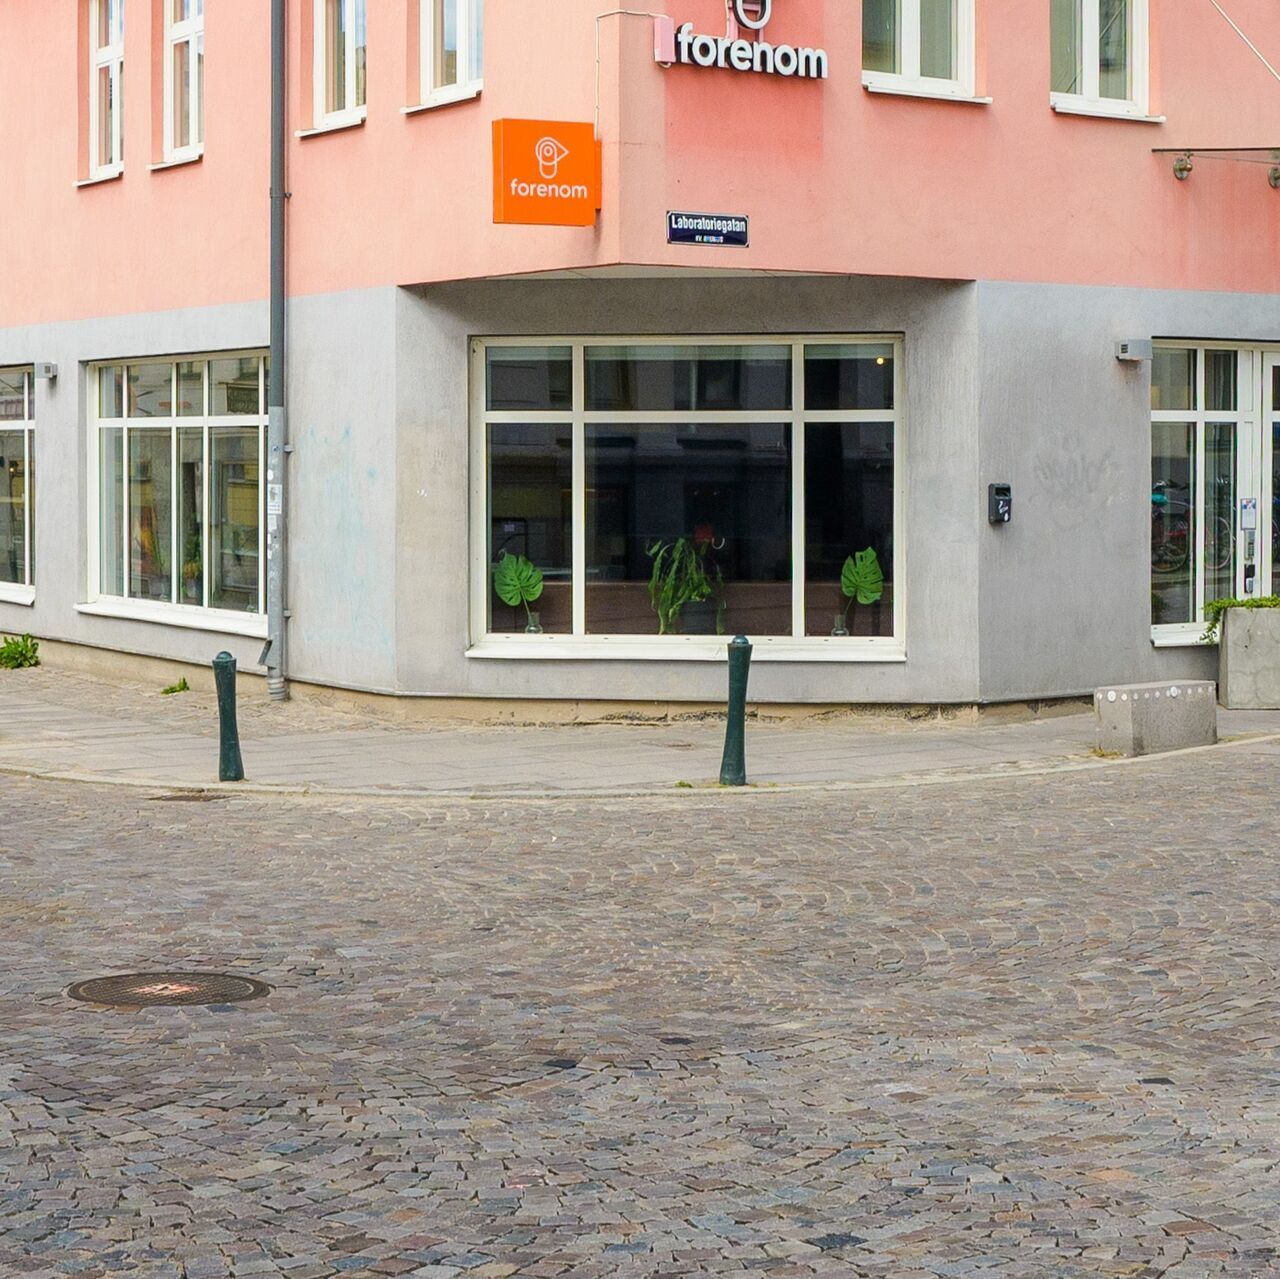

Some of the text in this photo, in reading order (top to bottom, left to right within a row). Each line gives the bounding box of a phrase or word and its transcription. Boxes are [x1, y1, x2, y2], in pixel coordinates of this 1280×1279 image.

[677, 22, 829, 79] forenom
[510, 178, 588, 199] forenom
[671, 214, 746, 234] Laboratoriegatan
